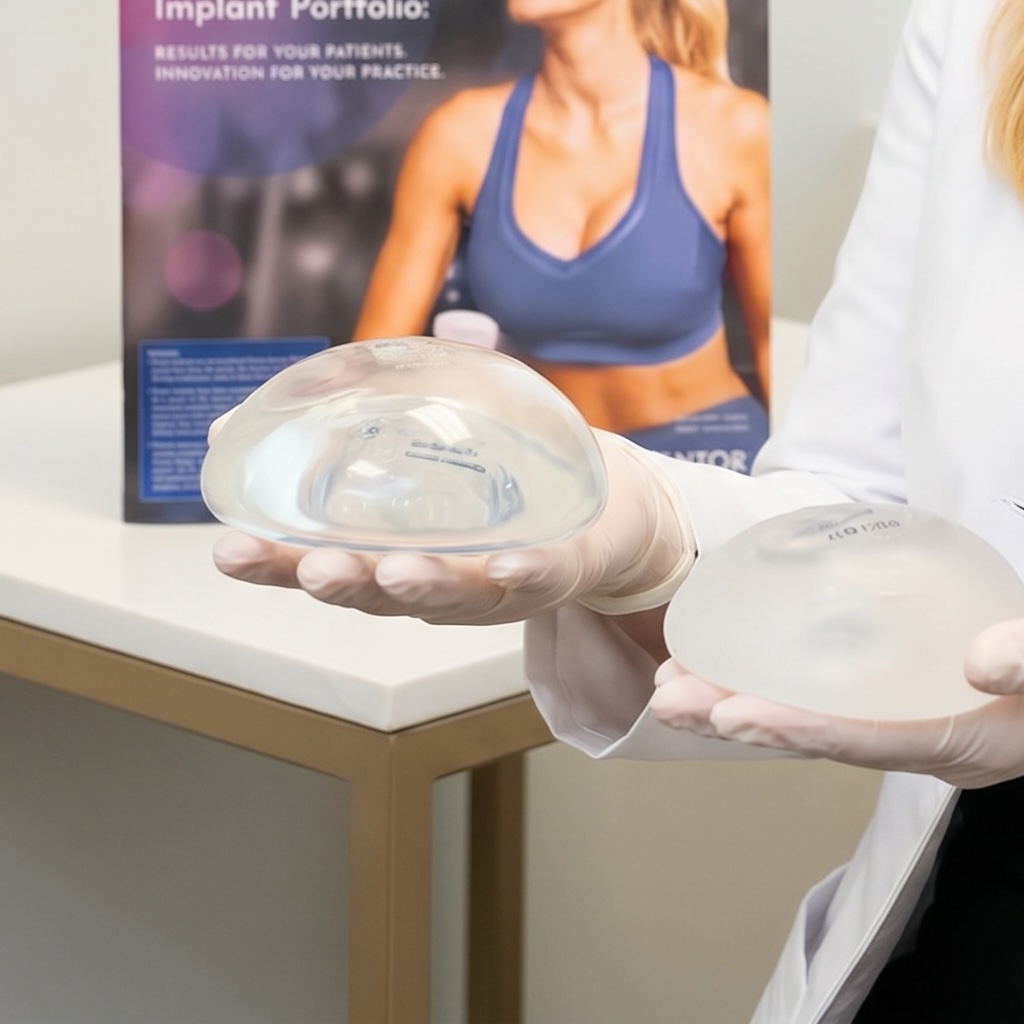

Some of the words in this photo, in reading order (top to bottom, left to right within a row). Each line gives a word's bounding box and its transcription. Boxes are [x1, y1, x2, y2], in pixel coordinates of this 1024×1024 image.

[154, 44, 228, 60] RESULTS
[233, 44, 268, 60] FOR
[272, 44, 321, 59] YOUR
[155, 65, 265, 81] INNOVATION
[270, 65, 304, 80] FOR
[308, 65, 357, 80] YOUR
[361, 63, 446, 80] PRACTICE.
